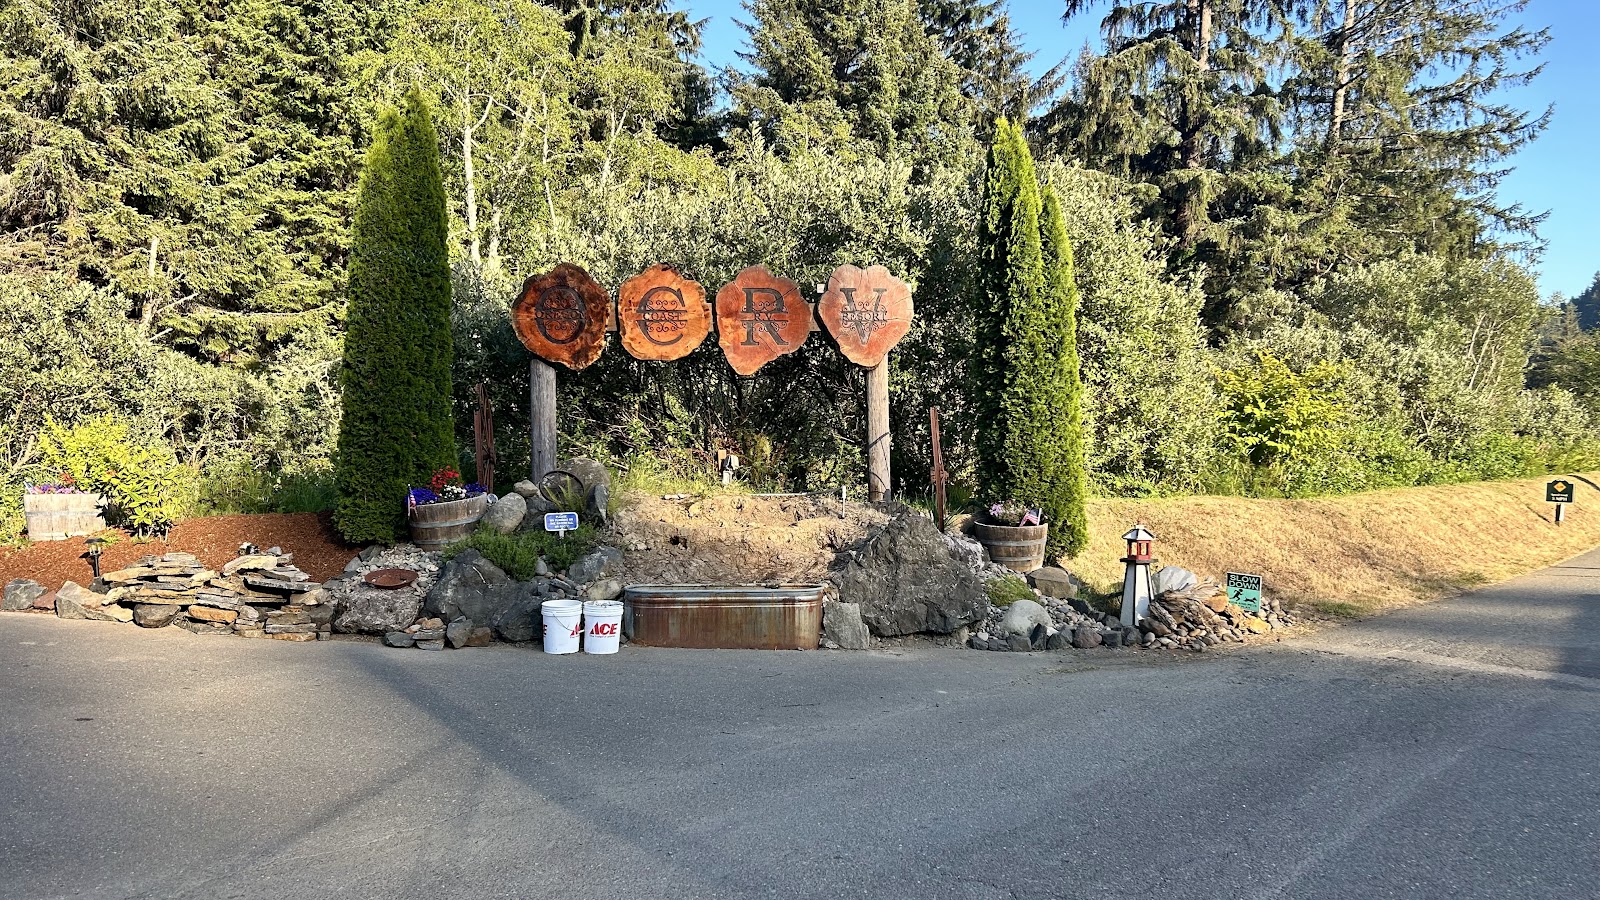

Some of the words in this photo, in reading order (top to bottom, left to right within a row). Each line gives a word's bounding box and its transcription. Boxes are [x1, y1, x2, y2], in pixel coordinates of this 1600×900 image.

[636, 286, 687, 346] C
[741, 287, 789, 346] R
[840, 288, 887, 345] V
[643, 312, 682, 321] COAST
[842, 311, 887, 321] RESORT
[1230, 575, 1259, 584] SLOW
[1229, 580, 1259, 590] DOWN
[589, 621, 618, 635] ACE
